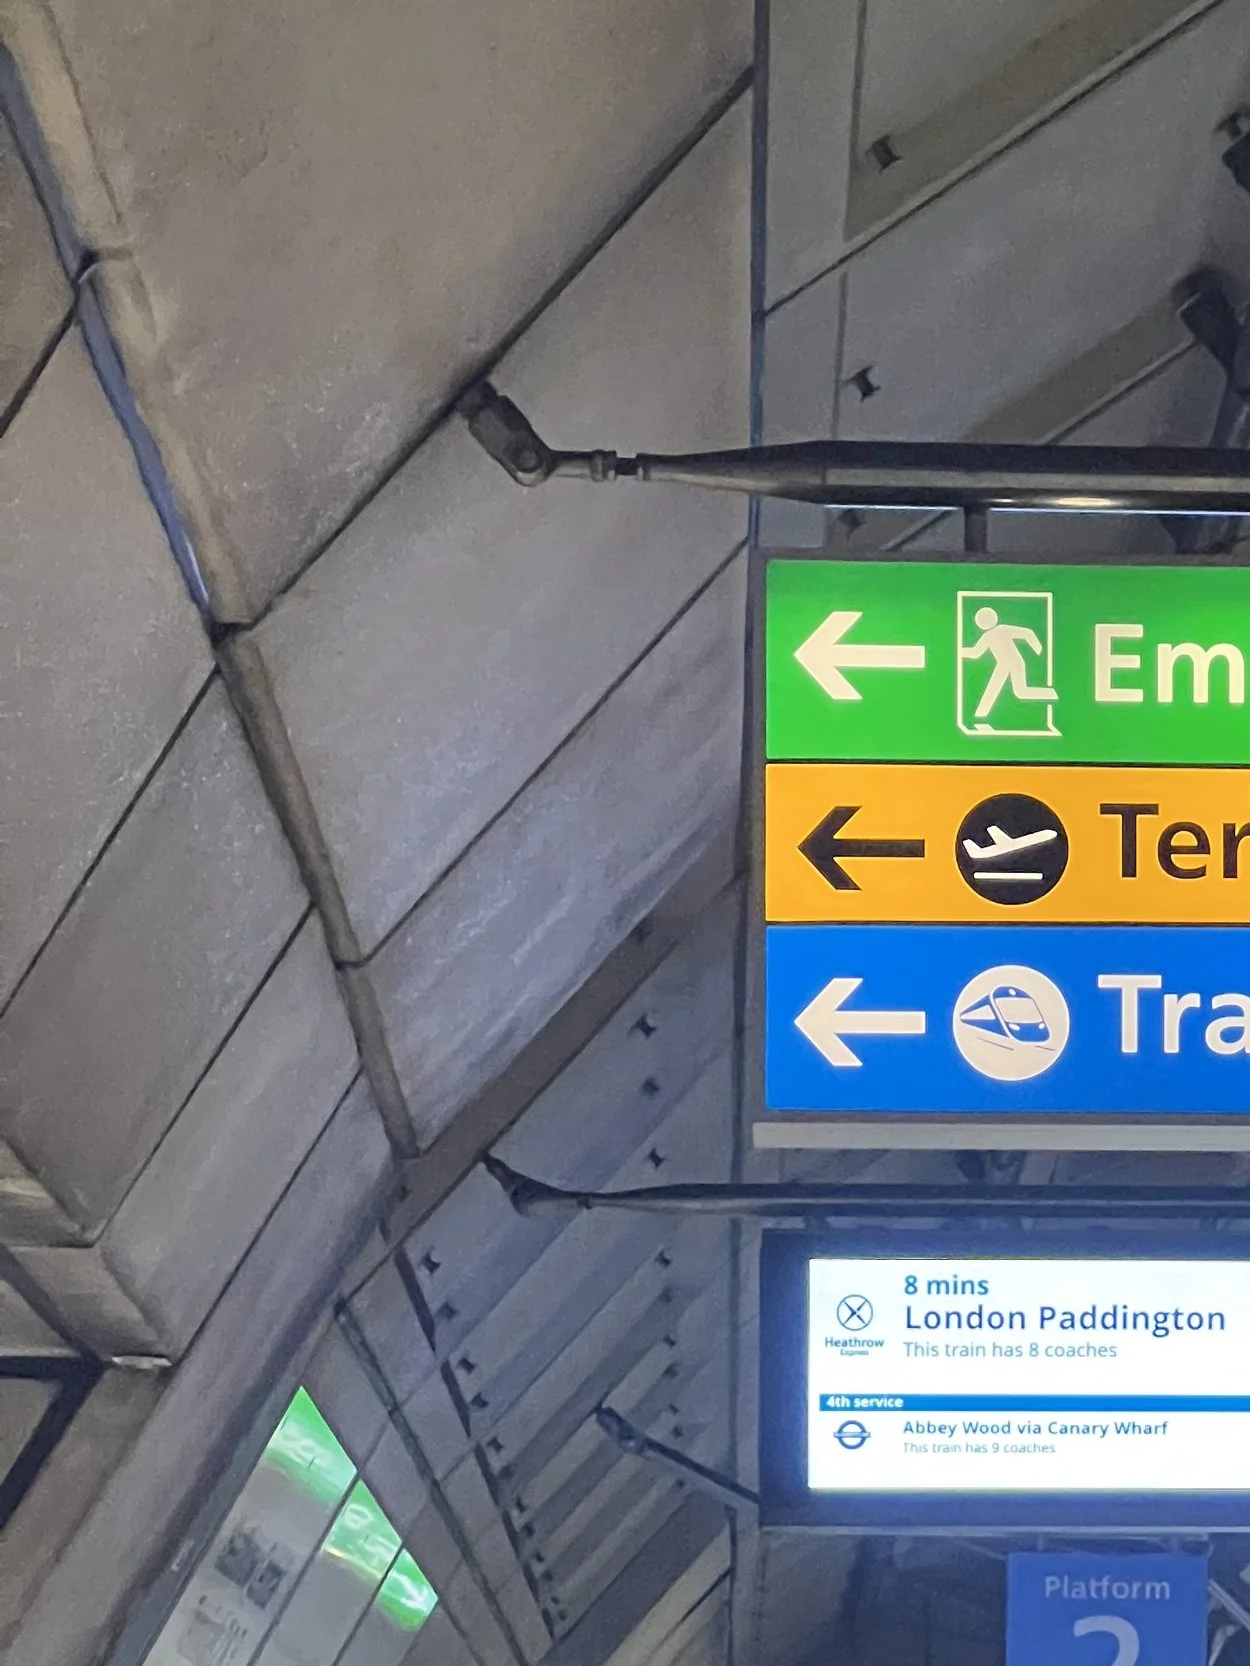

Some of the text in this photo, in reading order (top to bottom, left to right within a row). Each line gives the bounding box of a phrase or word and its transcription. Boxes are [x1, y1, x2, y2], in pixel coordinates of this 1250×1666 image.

[904, 1274, 989, 1295] 8 mins
[906, 1304, 1226, 1338] London Paddington
[824, 1336, 884, 1348] Heathrow
[903, 1341, 1117, 1358] This train has 8 coaches
[826, 1395, 904, 1408] 4th service
[903, 1420, 1169, 1438] Abbey Wood via Canary Wharf
[903, 1442, 1056, 1454] This train has 9 coaches
[1045, 1575, 1171, 1599] Platform
